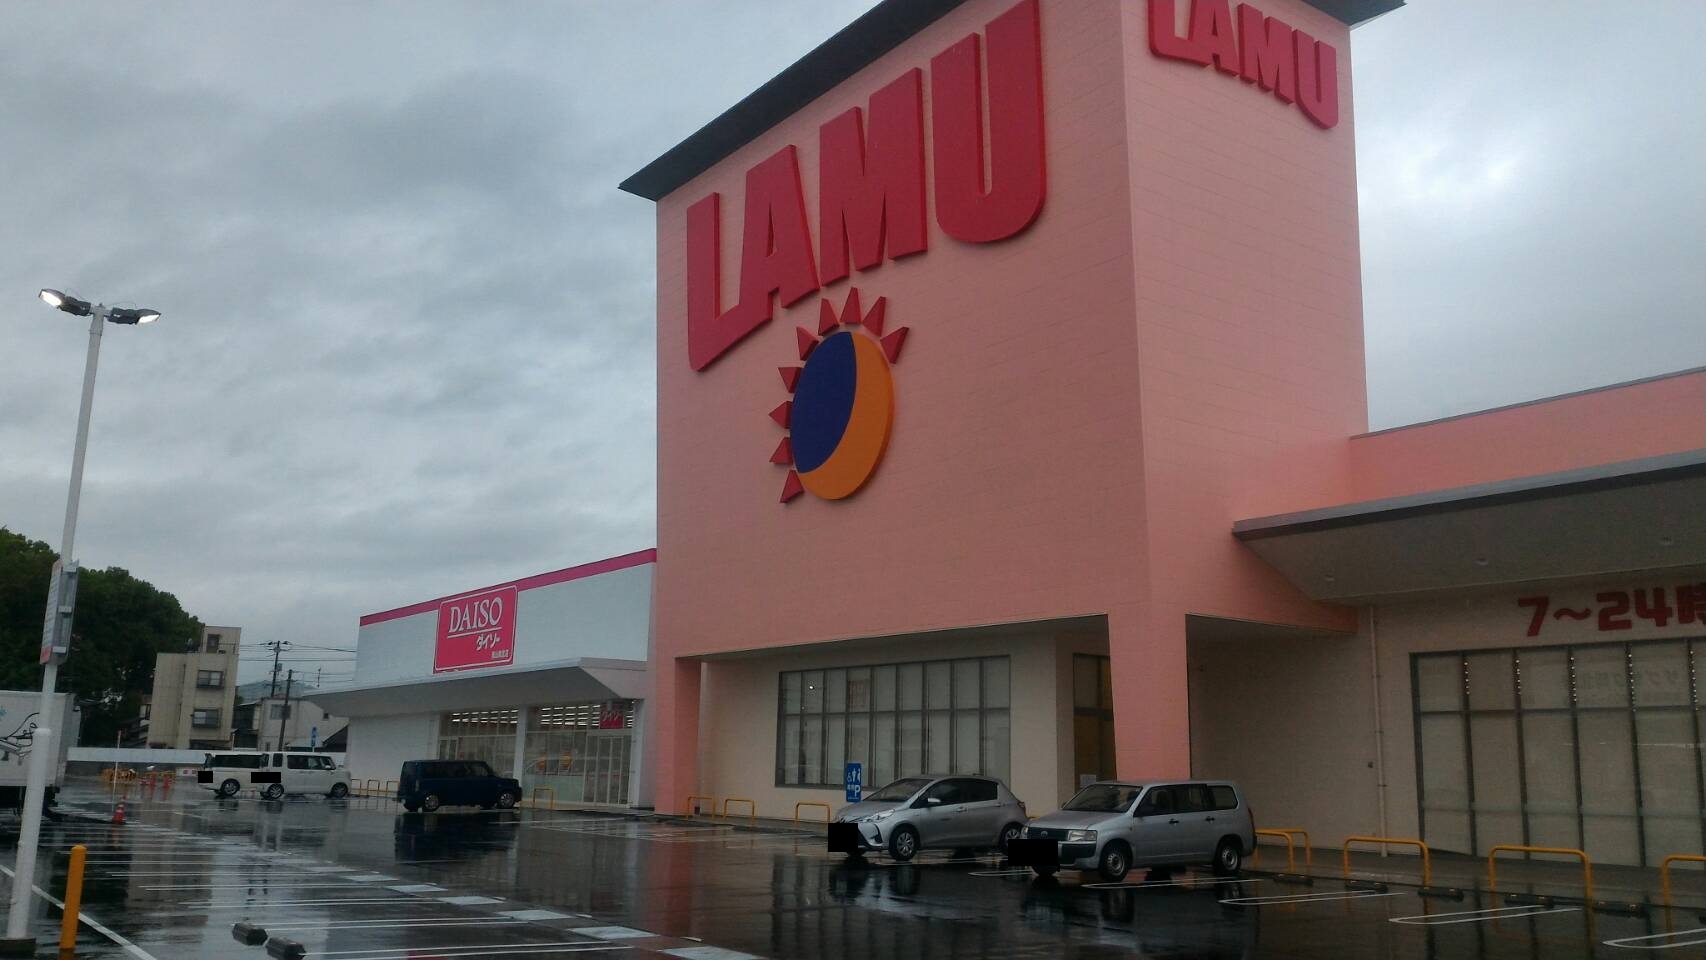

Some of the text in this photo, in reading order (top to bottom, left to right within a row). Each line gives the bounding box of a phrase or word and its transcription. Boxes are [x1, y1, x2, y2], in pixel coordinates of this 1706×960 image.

[1148, 0, 1338, 129] LAMU
[687, 0, 1046, 371] LAMU
[448, 597, 503, 633] DAISO
[476, 632, 501, 651] ダイソー
